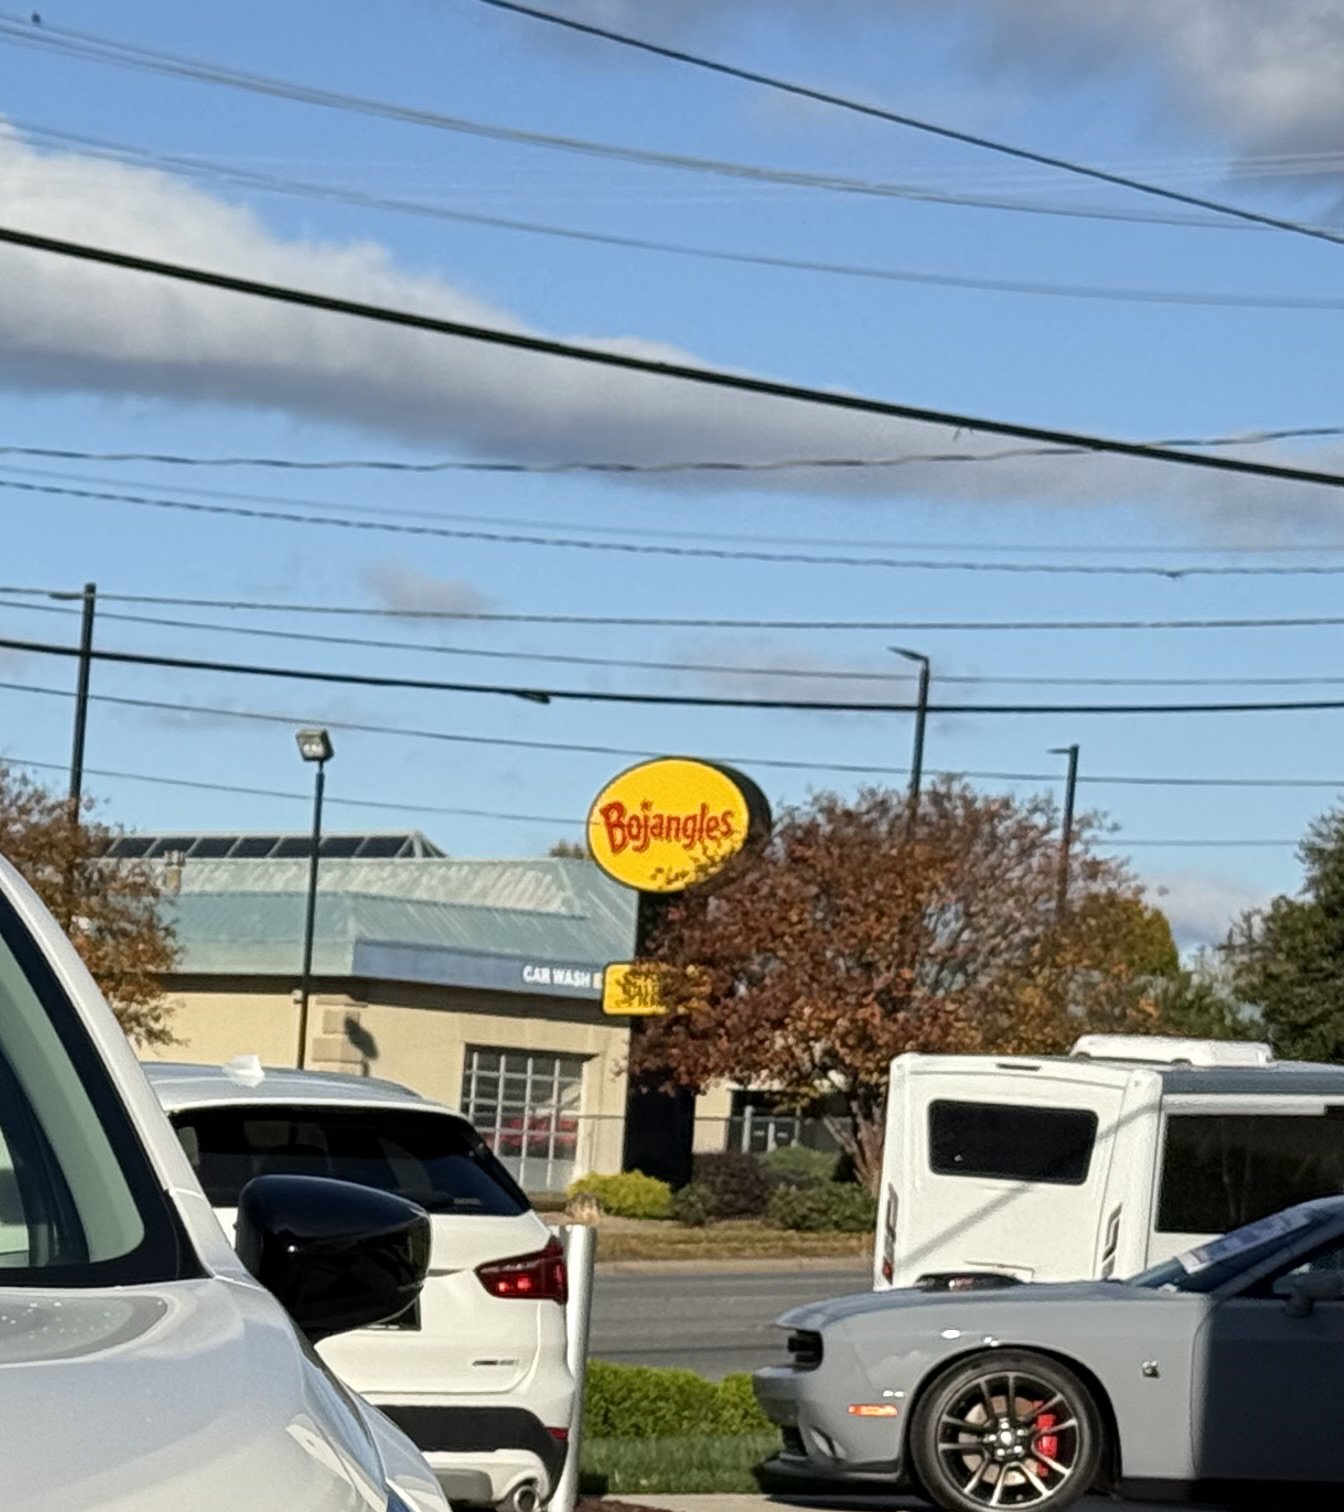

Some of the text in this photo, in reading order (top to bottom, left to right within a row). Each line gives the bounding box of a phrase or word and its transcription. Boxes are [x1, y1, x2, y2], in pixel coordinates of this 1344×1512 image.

[599, 800, 734, 855] Bojangles
[522, 964, 551, 985] CAR
[552, 967, 591, 989] WASH
